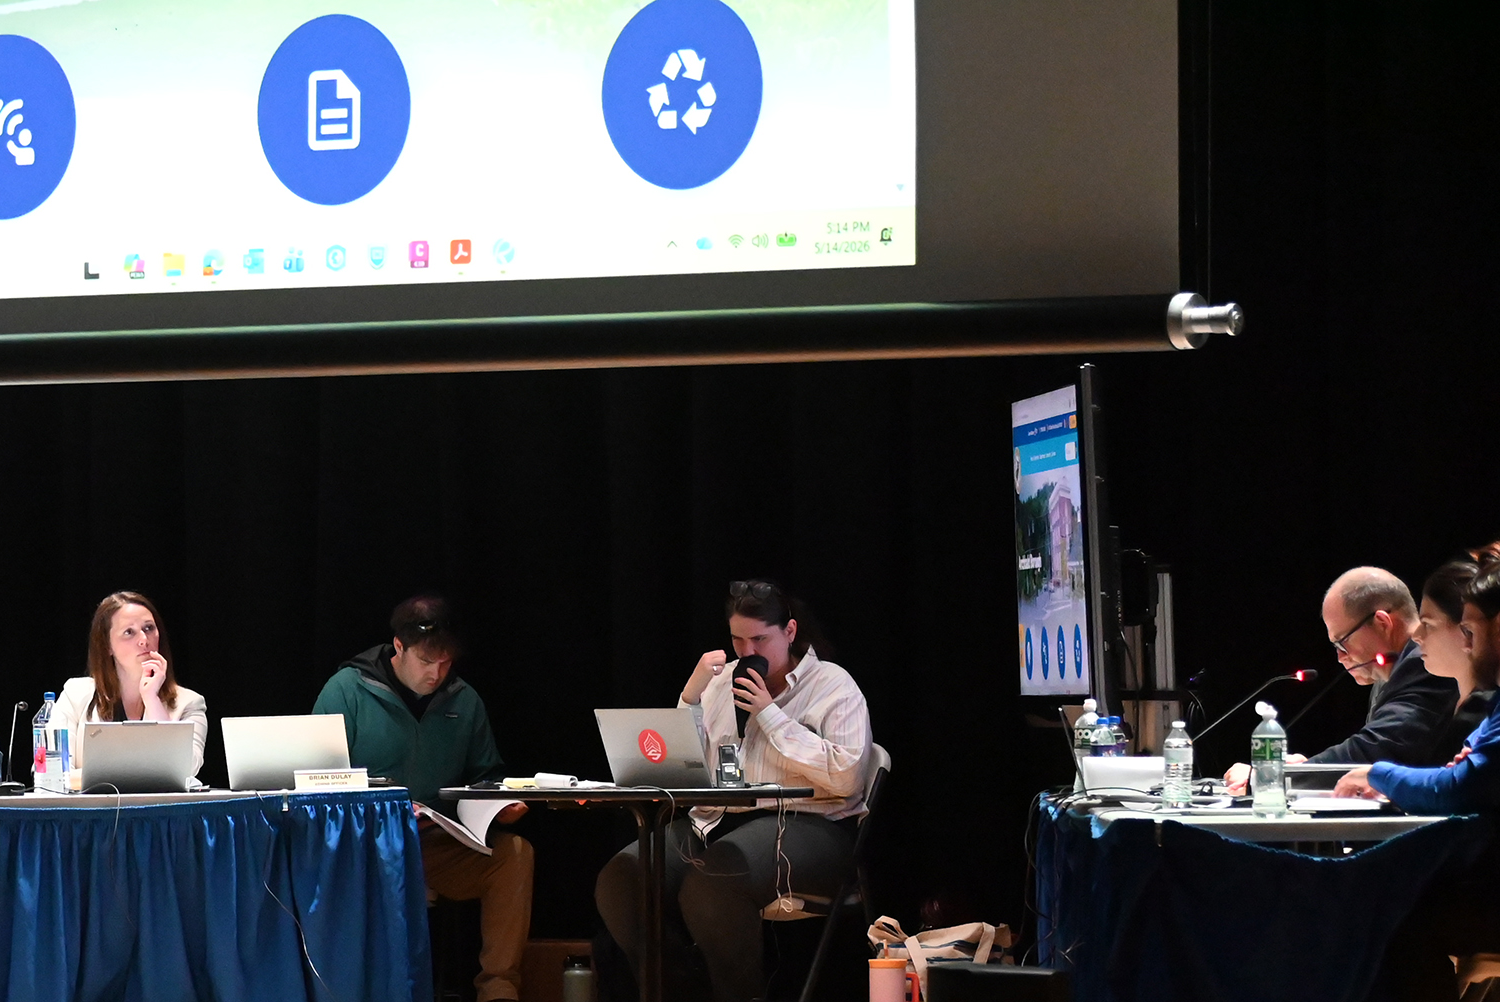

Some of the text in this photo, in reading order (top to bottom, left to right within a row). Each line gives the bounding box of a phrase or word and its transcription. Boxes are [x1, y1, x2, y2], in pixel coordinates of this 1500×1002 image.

[826, 221, 870, 234] 5:14 PM
[815, 240, 870, 254] 5/14/2026
